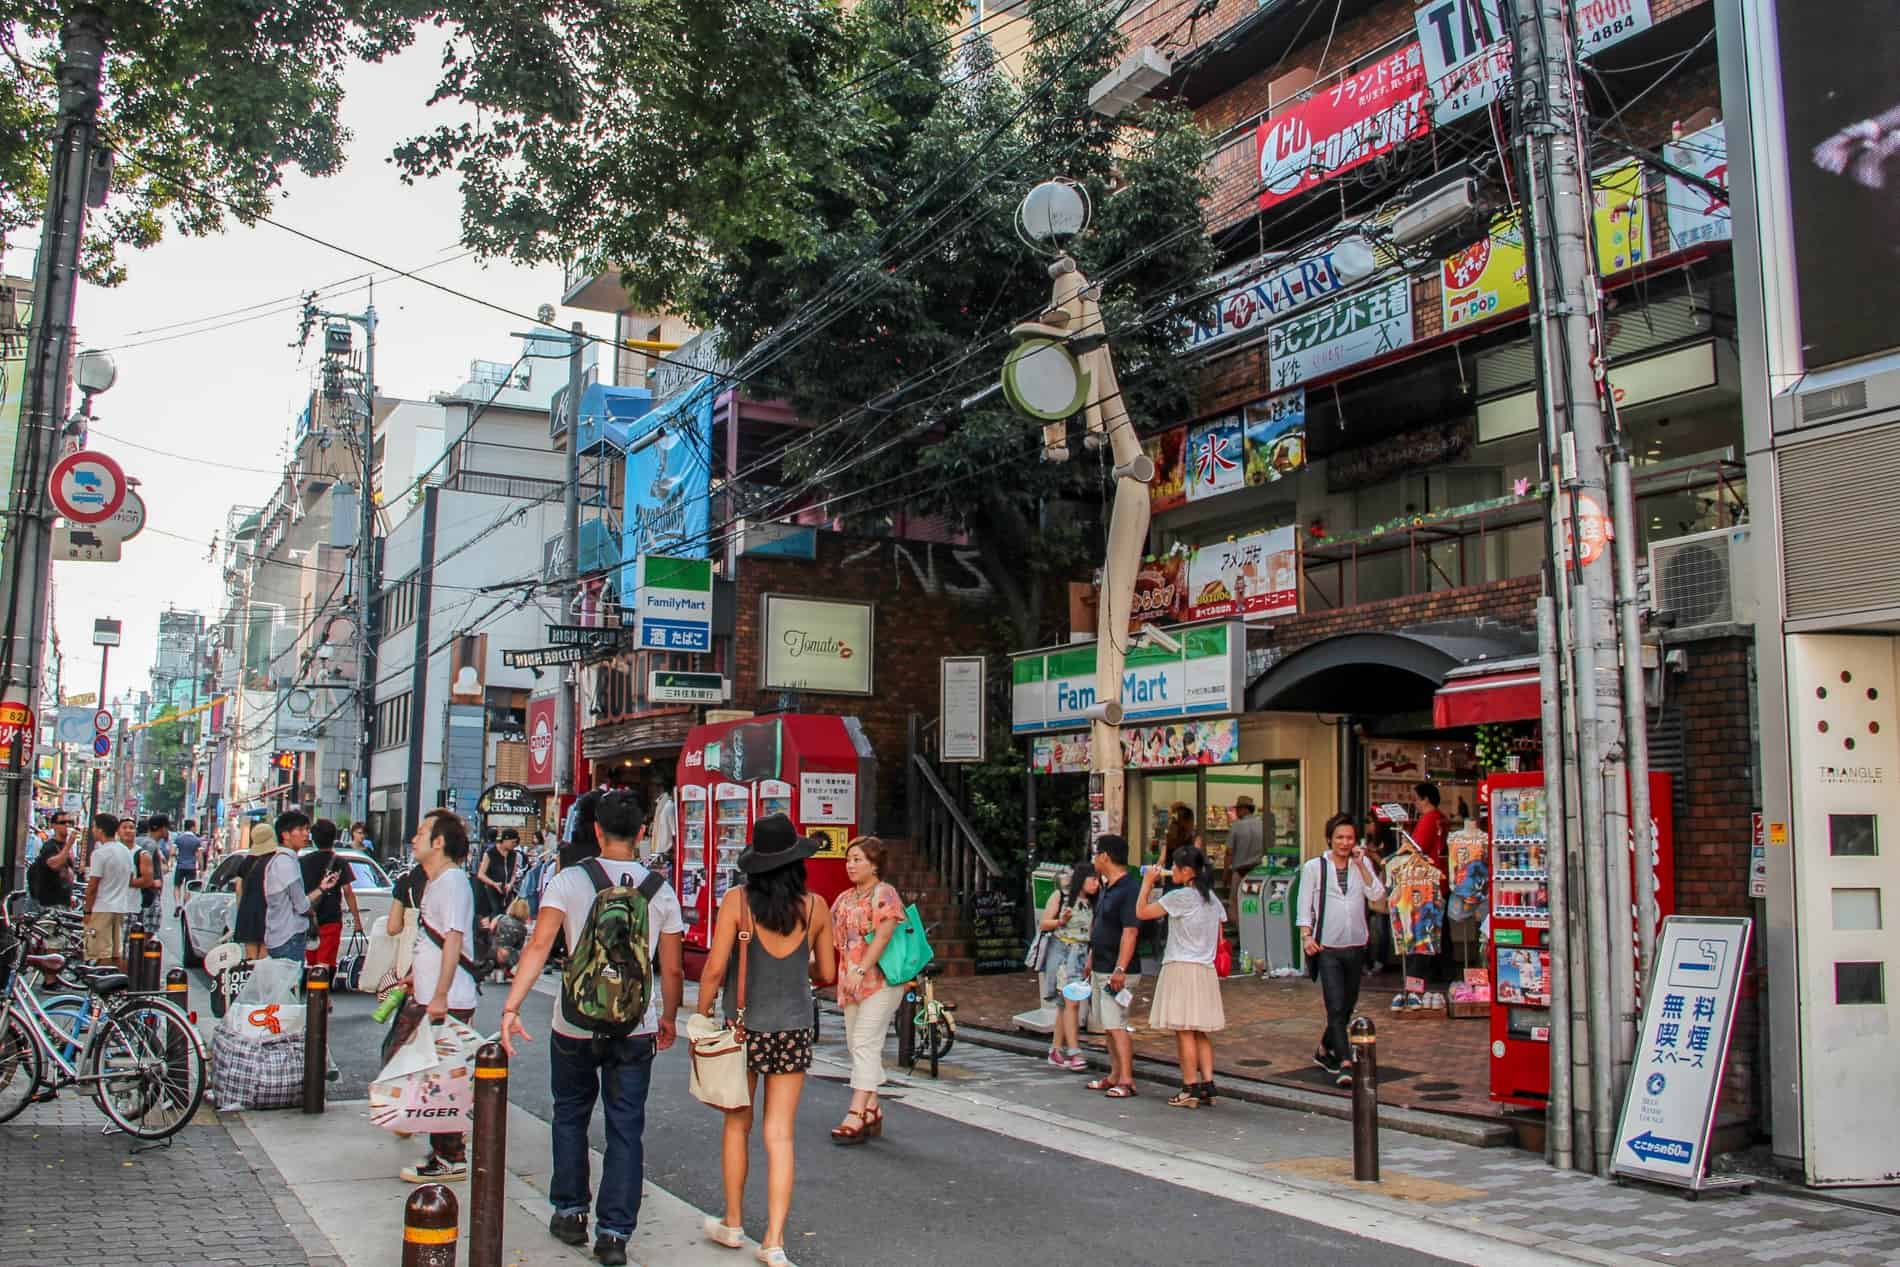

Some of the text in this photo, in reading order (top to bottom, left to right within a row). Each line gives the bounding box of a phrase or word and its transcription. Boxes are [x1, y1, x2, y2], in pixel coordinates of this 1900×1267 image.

[1197, 434, 1237, 486] 氷
[647, 596, 705, 611] FamilyMart
[1247, 592, 1296, 609] フードコート
[551, 629, 577, 642] HIGH
[651, 628, 704, 646] 酒 たばこ
[783, 630, 838, 657] Tomato
[515, 648, 581, 667] HIGH ROLLER
[1819, 766, 1883, 778] TRIANGLE
[494, 789, 522, 800] B2F
[1661, 993, 1716, 1022] 無料
[1656, 1022, 1712, 1051] 喫煙
[1651, 1050, 1704, 1068] スペース
[405, 1107, 459, 1118] TIGER
